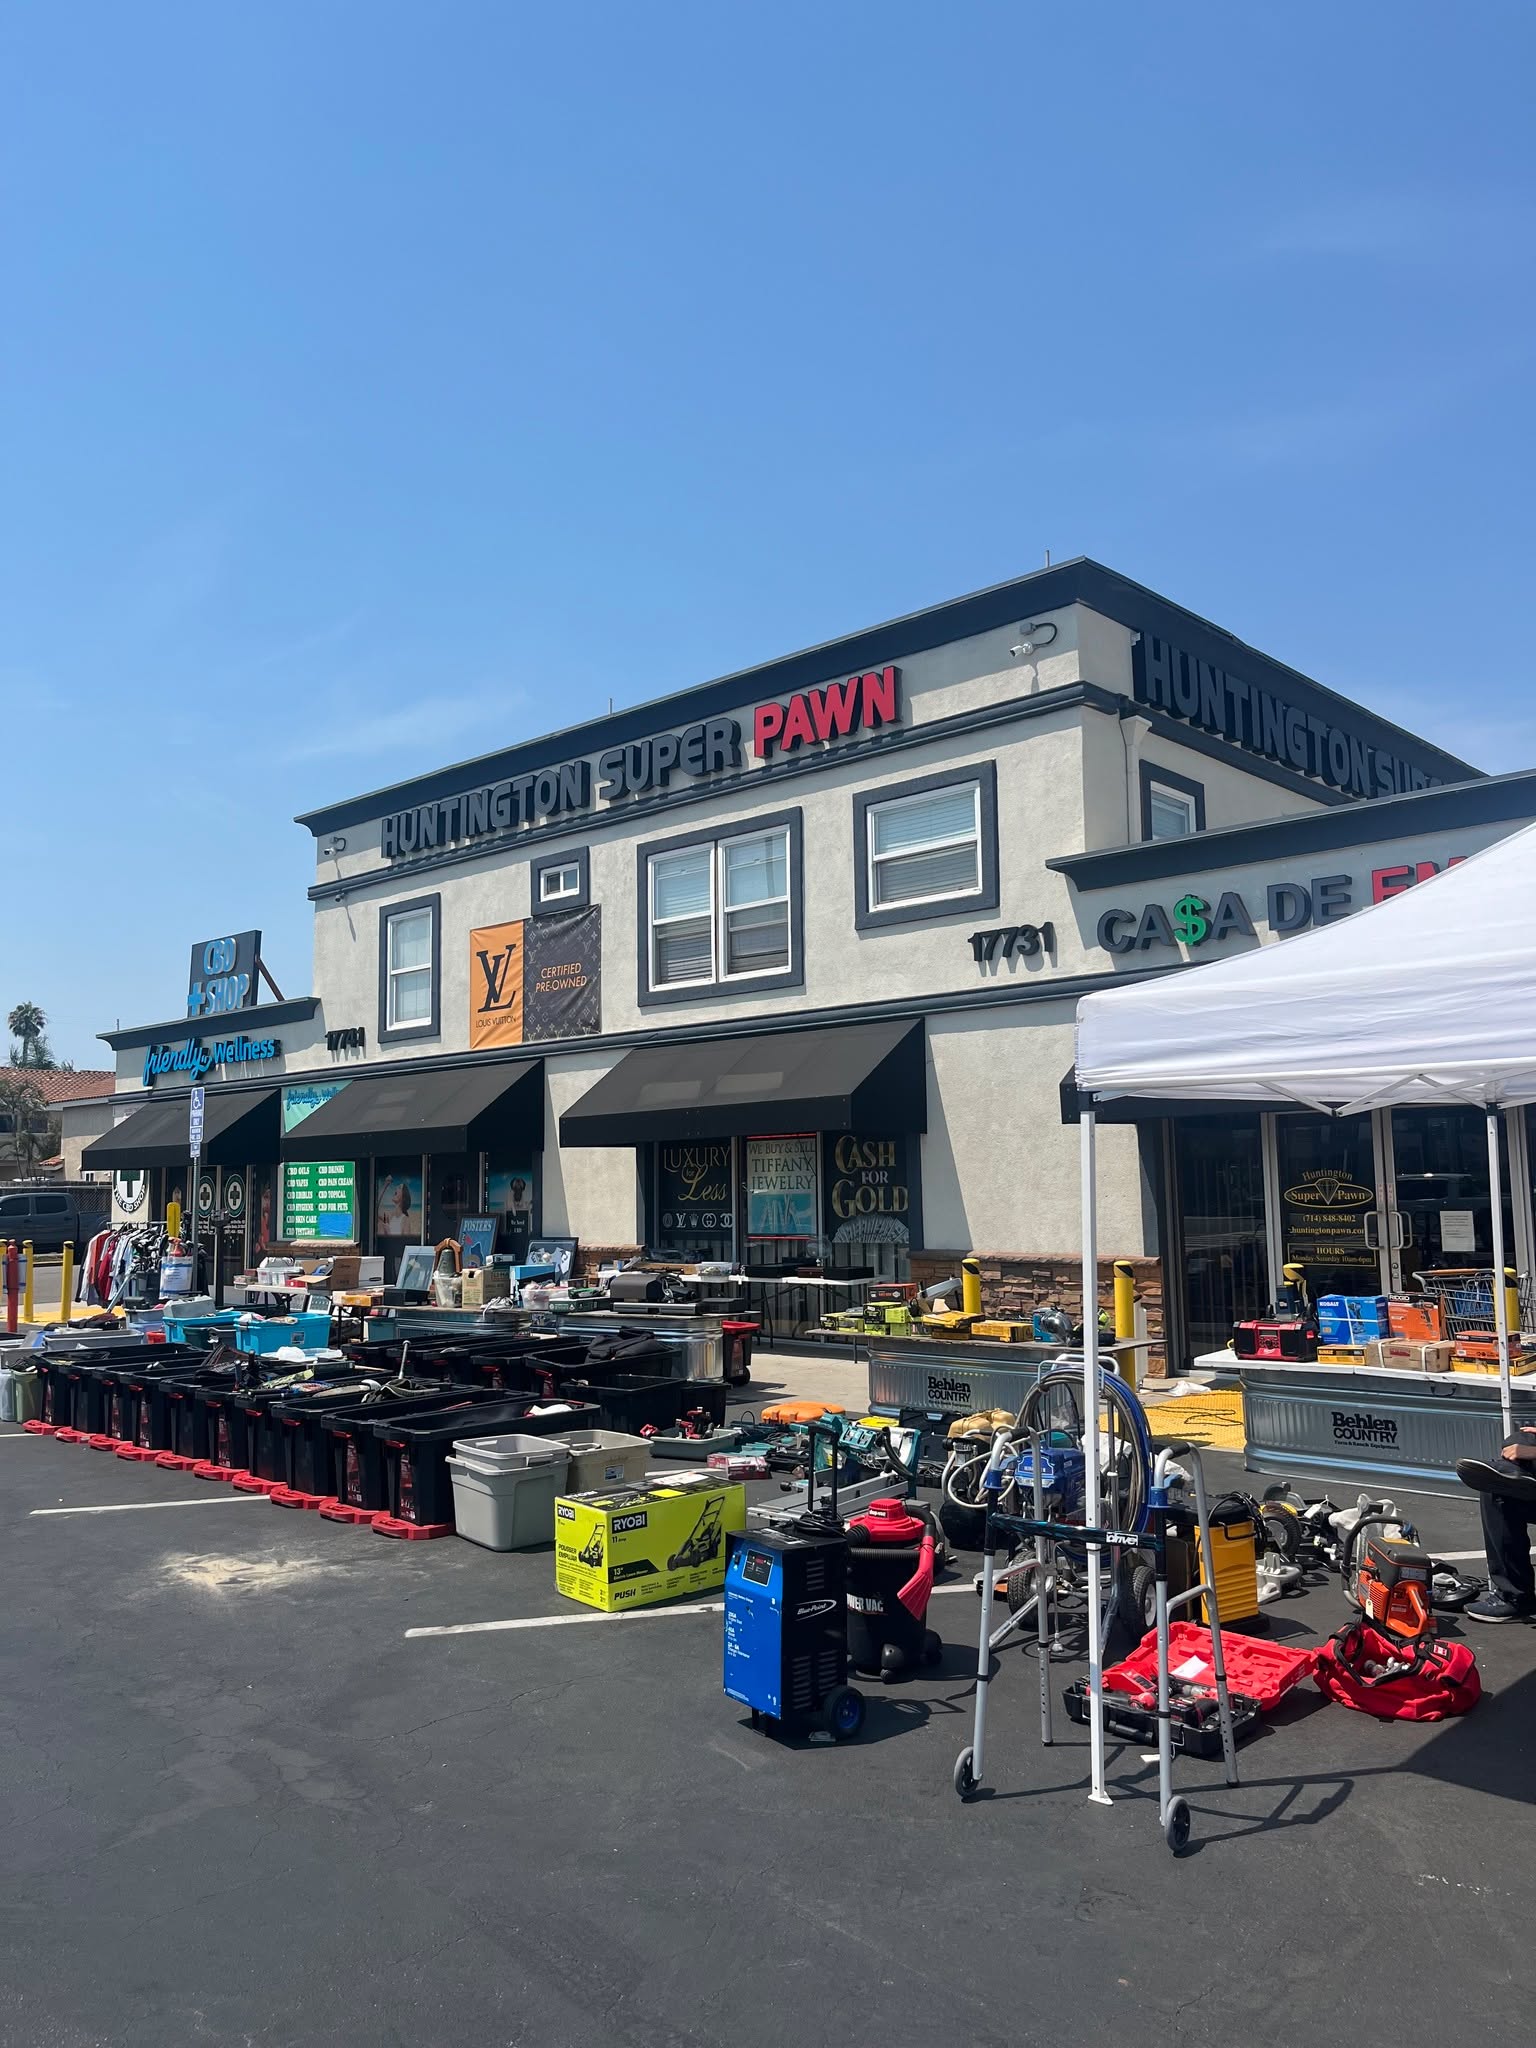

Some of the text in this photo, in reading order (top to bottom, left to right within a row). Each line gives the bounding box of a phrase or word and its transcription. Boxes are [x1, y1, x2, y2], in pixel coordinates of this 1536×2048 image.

[1135, 631, 1370, 797] HUNTINGTON
[381, 665, 901, 859] HUNTINGTON SUPER PAWN
[1267, 874, 1353, 931] DE
[967, 921, 1054, 962] 17731
[203, 937, 237, 975] CBD
[541, 962, 582, 979] CERTIFIED
[535, 975, 588, 992] PRE-OWNED
[475, 1018, 491, 1028] LOUIS
[325, 1026, 366, 1051] 17741
[143, 1035, 280, 1087] friendly Wellness
[765, 1143, 784, 1154] BUY
[834, 1135, 897, 1174] CASH
[664, 1146, 731, 1172] LUXURY
[752, 1157, 814, 1173] TIFFANY
[678, 1163, 726, 1200] Less
[752, 1175, 815, 1190] JEWELRY
[861, 1171, 888, 1184] FOR
[1302, 1169, 1353, 1182] Huntington
[832, 1179, 909, 1218] GOLD
[1291, 1190, 1320, 1203] Super
[1337, 1190, 1365, 1200] Pawn
[122, 1201, 134, 1213] CBD
[1303, 1214, 1356, 1222] (714) 848-8402
[1316, 1247, 1345, 1255] HOURS
[928, 1375, 971, 1392] Behlen
[928, 1389, 971, 1402] COUNTRY
[1331, 1411, 1398, 1431] Behlen
[1333, 1427, 1398, 1443] COUNTRY
[558, 1505, 575, 1519] RYOBI
[613, 1513, 646, 1531] RYOBI
[614, 1589, 636, 1601] PUSH
[865, 1598, 883, 1612] VAC
